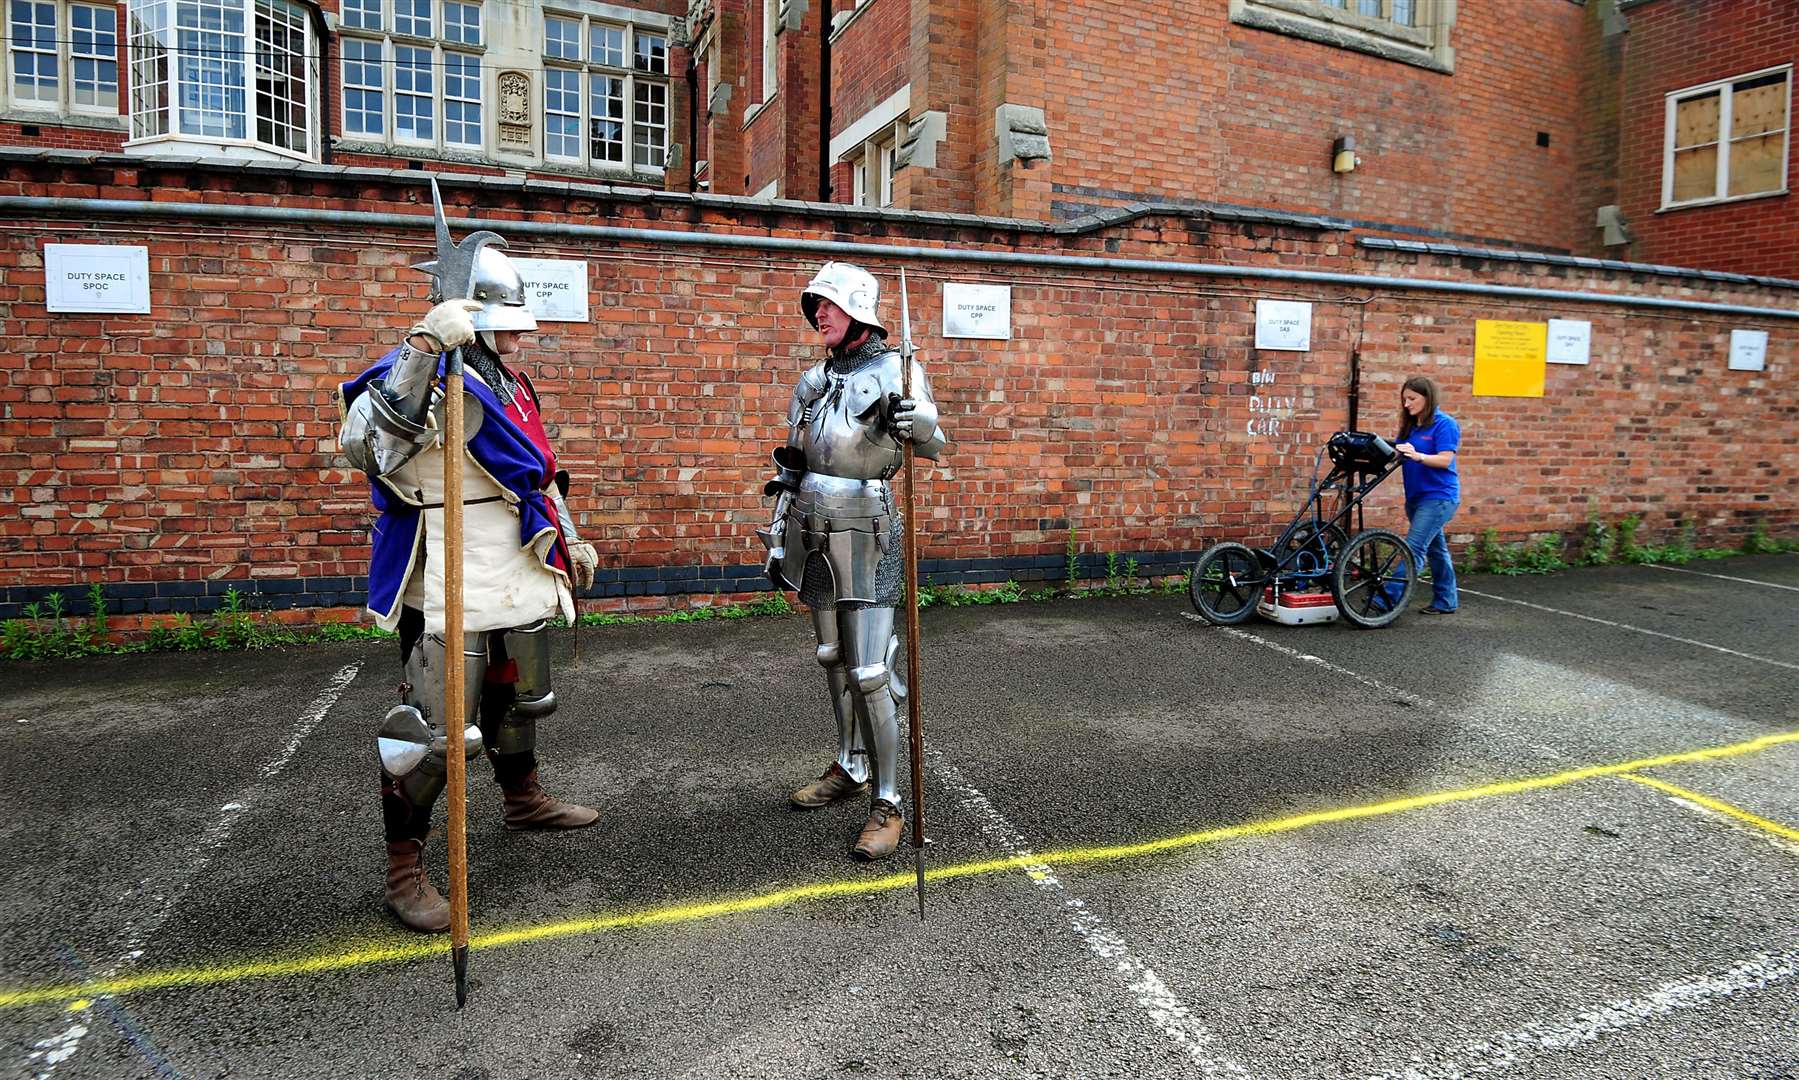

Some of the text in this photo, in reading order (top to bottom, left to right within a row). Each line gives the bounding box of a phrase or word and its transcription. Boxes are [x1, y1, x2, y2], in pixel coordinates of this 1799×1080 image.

[67, 272, 126, 281] DUTY SPACE
[83, 282, 109, 290] SPOC
[542, 282, 569, 290] SPACE
[1252, 368, 1276, 387] B/W
[1247, 417, 1280, 437] CAR
